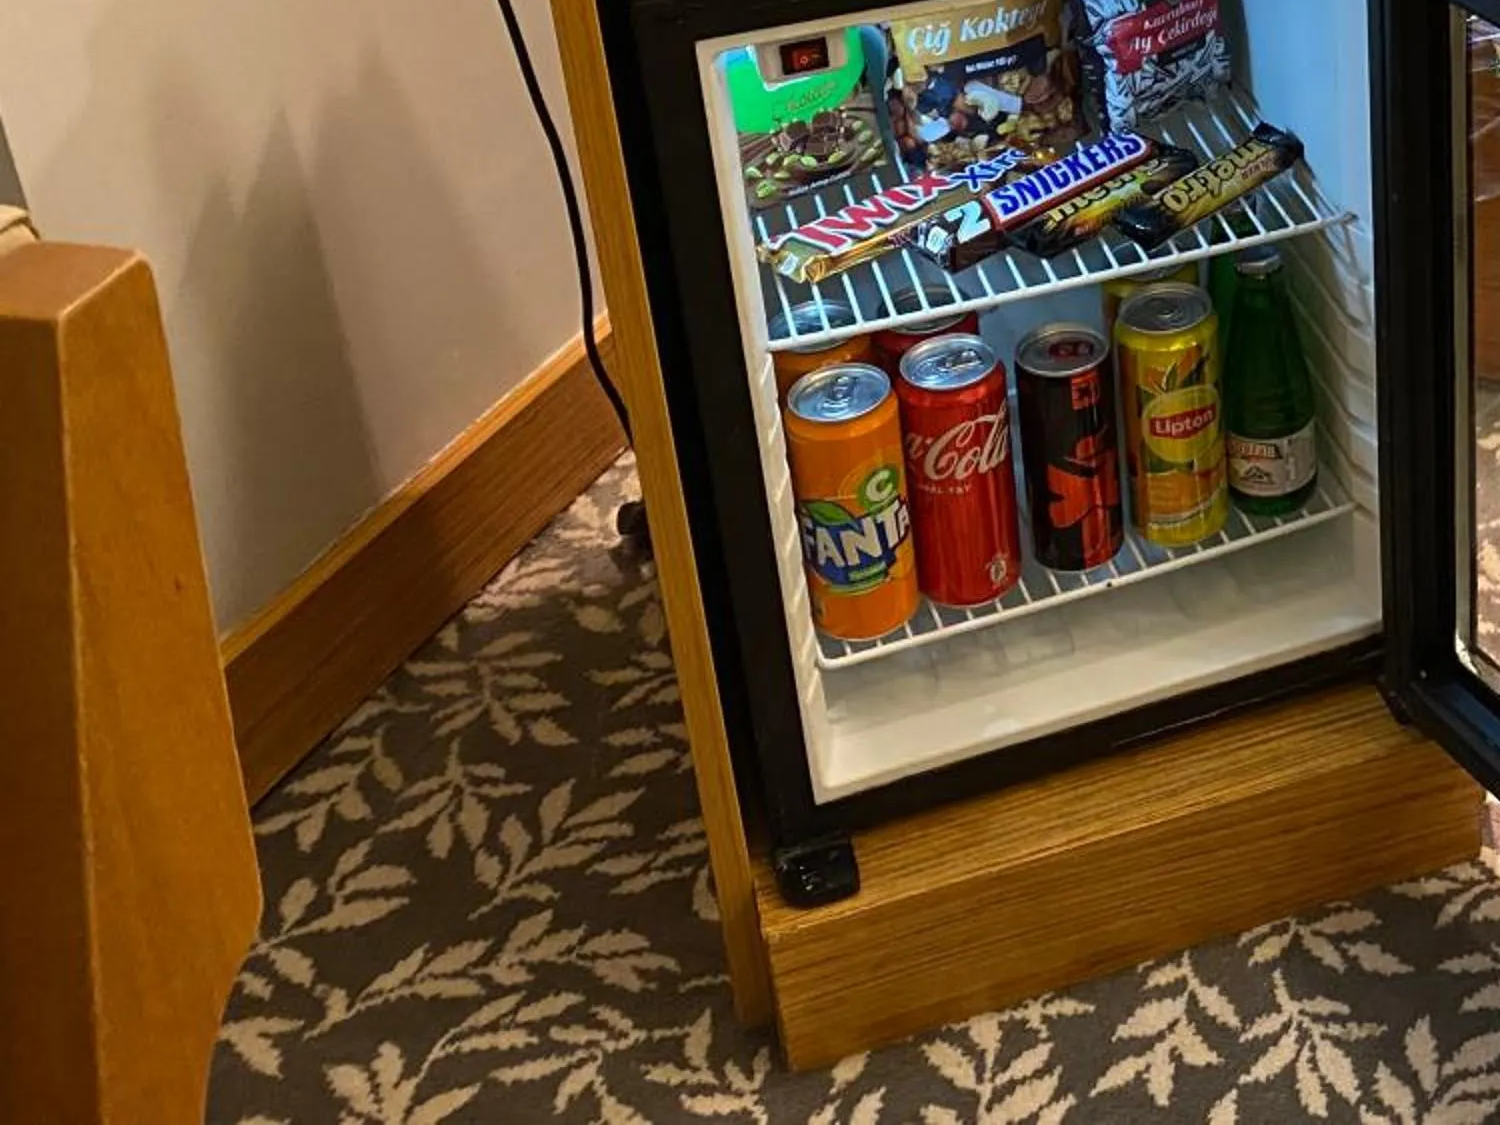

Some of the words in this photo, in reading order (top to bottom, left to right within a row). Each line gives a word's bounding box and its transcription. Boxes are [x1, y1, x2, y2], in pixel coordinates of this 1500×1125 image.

[998, 131, 1145, 217] SNICKERS
[1161, 135, 1272, 215] metro
[1155, 408, 1214, 436] Lipton
[802, 499, 910, 568] FANTA
